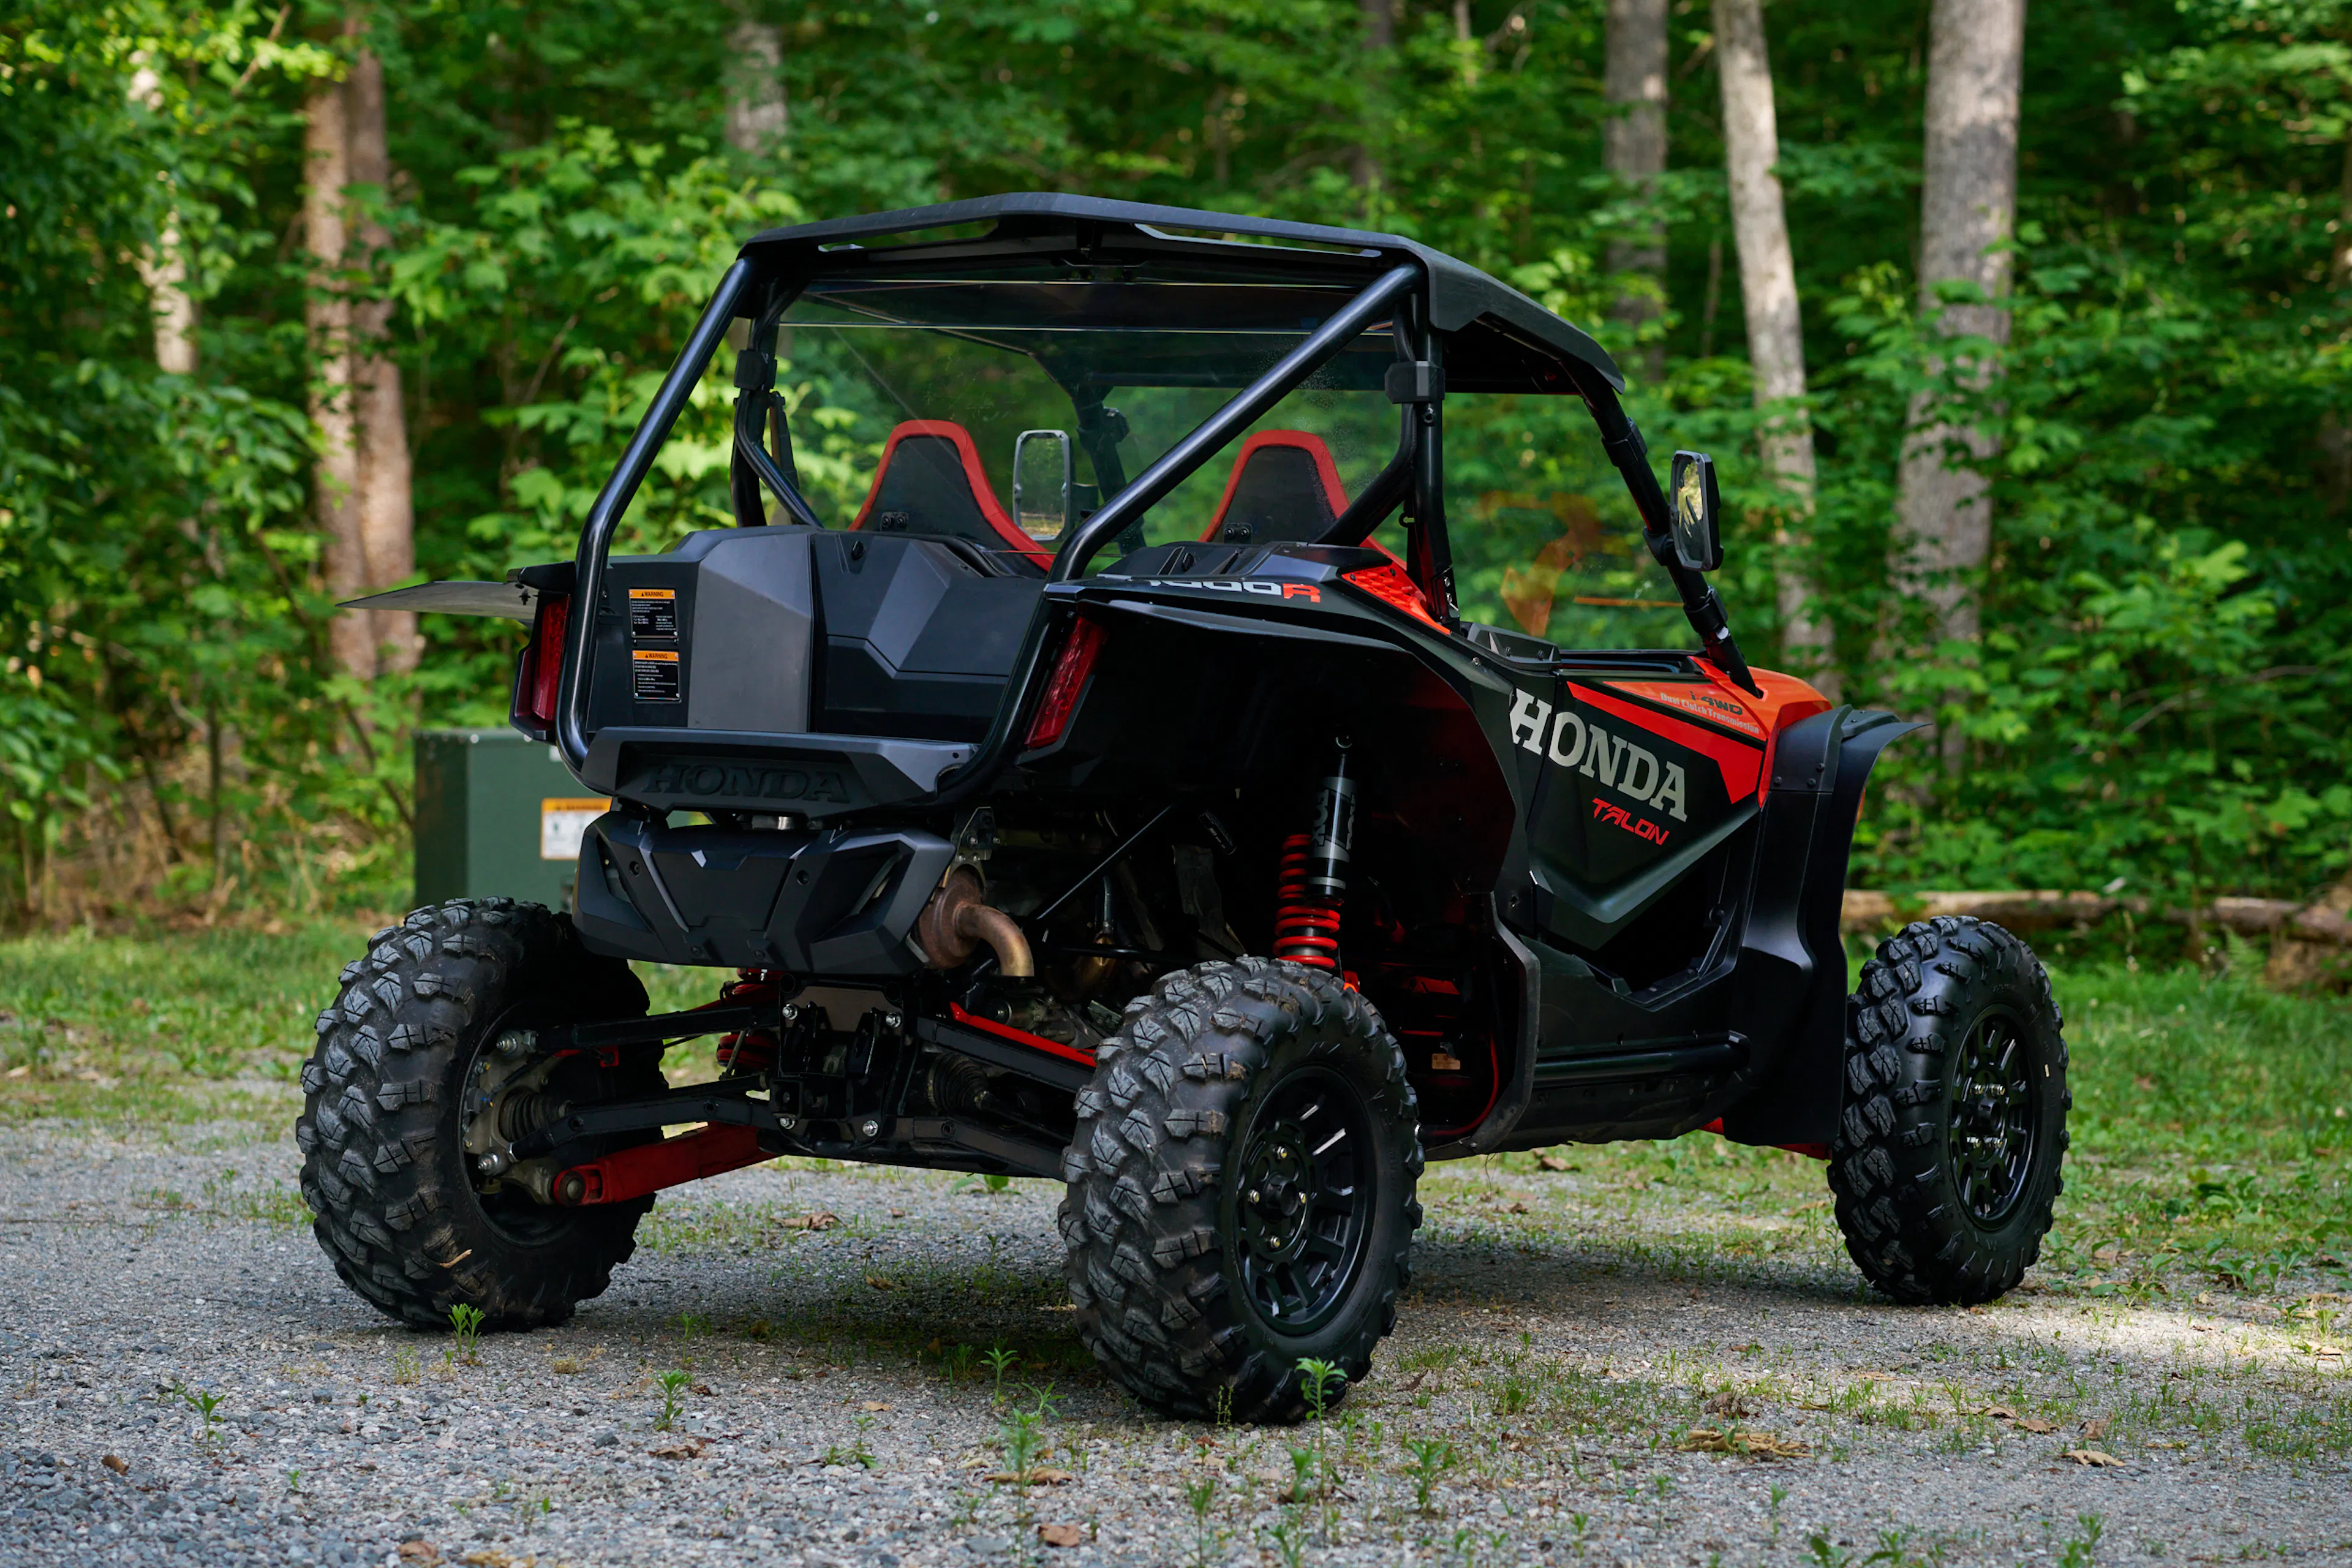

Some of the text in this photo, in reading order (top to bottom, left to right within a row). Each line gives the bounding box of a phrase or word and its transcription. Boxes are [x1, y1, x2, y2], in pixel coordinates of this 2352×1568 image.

[1660, 693, 1760, 734] Dual Clutch Transmission
[1509, 687, 1687, 823] HONDA
[642, 764, 851, 804] HONDA
[1593, 797, 1670, 845] TALON
